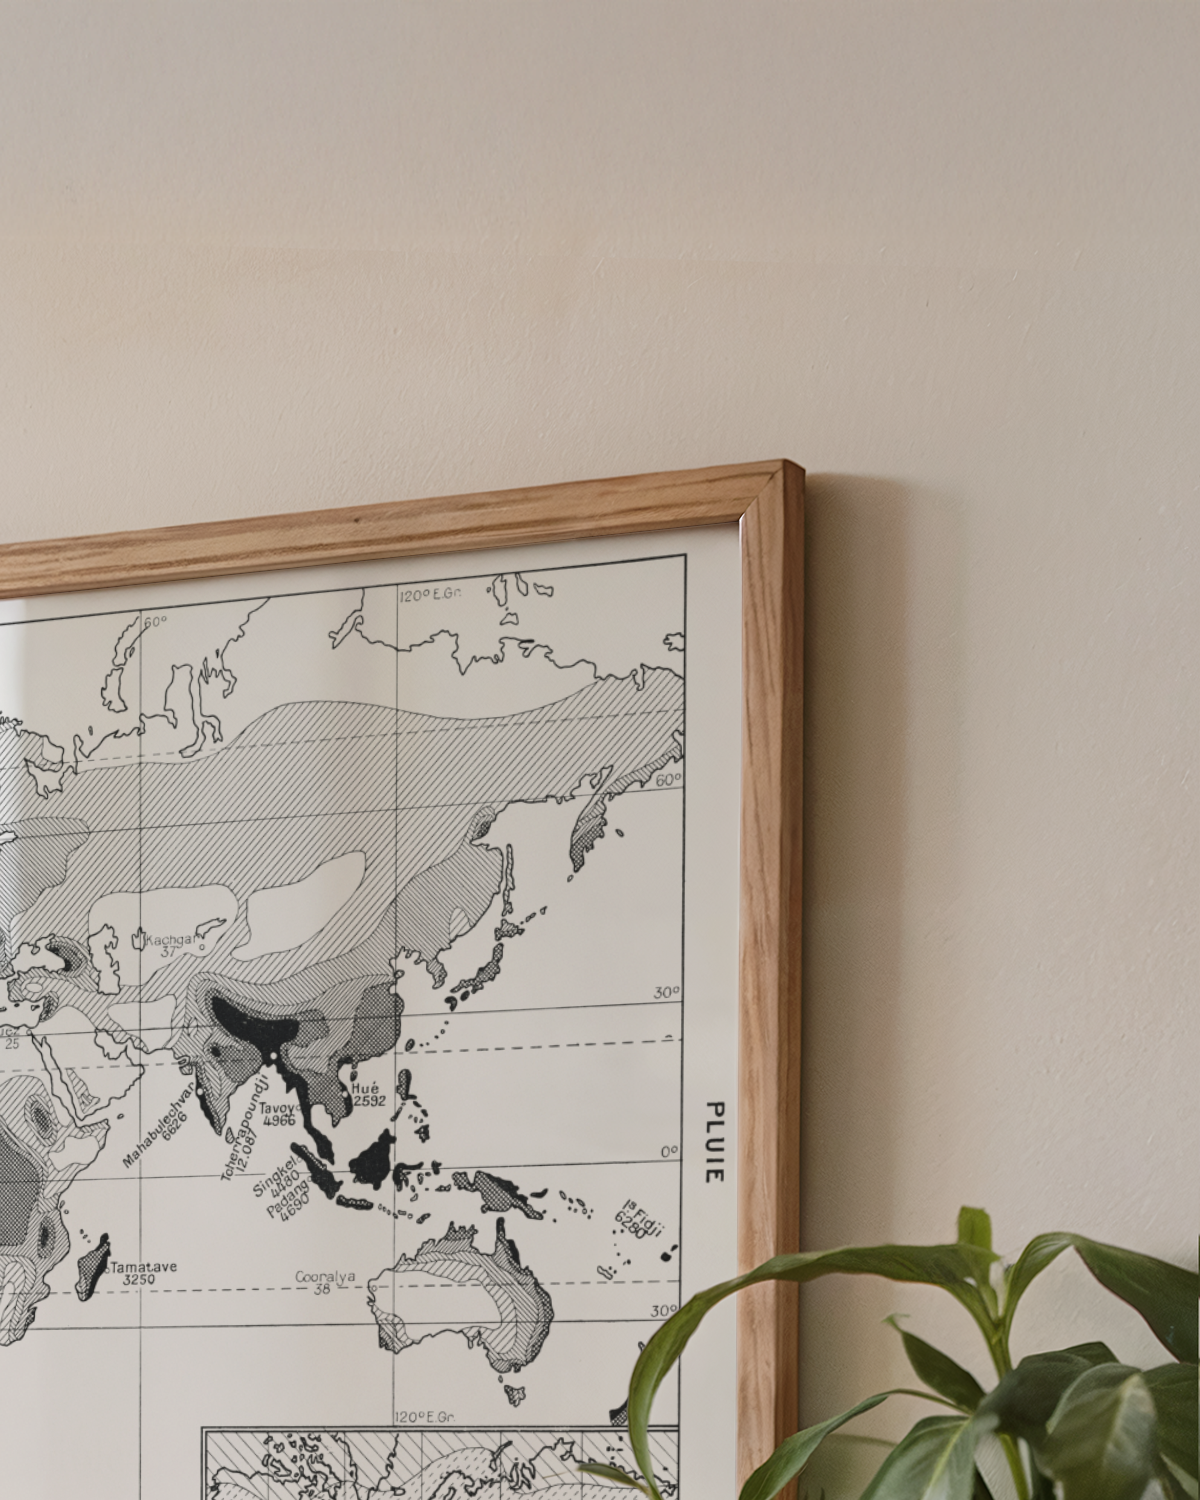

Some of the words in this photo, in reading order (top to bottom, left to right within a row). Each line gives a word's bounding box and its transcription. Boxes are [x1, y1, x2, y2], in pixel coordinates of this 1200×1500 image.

[160, 945, 177, 958] 37
[4, 1037, 20, 1050] 25
[351, 1081, 379, 1094] Hué
[353, 1095, 386, 1107] 2592
[259, 1101, 294, 1117] Tavoy
[162, 1111, 188, 1141] 6626
[263, 1114, 296, 1126] 4966
[705, 1100, 725, 1184] PLUIE
[253, 1155, 297, 1197] Singkel
[271, 1169, 300, 1198] 4480
[266, 1180, 309, 1219] Padang
[281, 1192, 309, 1222] 4690
[615, 1210, 647, 1239] 6280
[110, 1261, 177, 1274] Tamatave
[123, 1273, 155, 1286] 3250
[313, 1282, 331, 1295] 38
